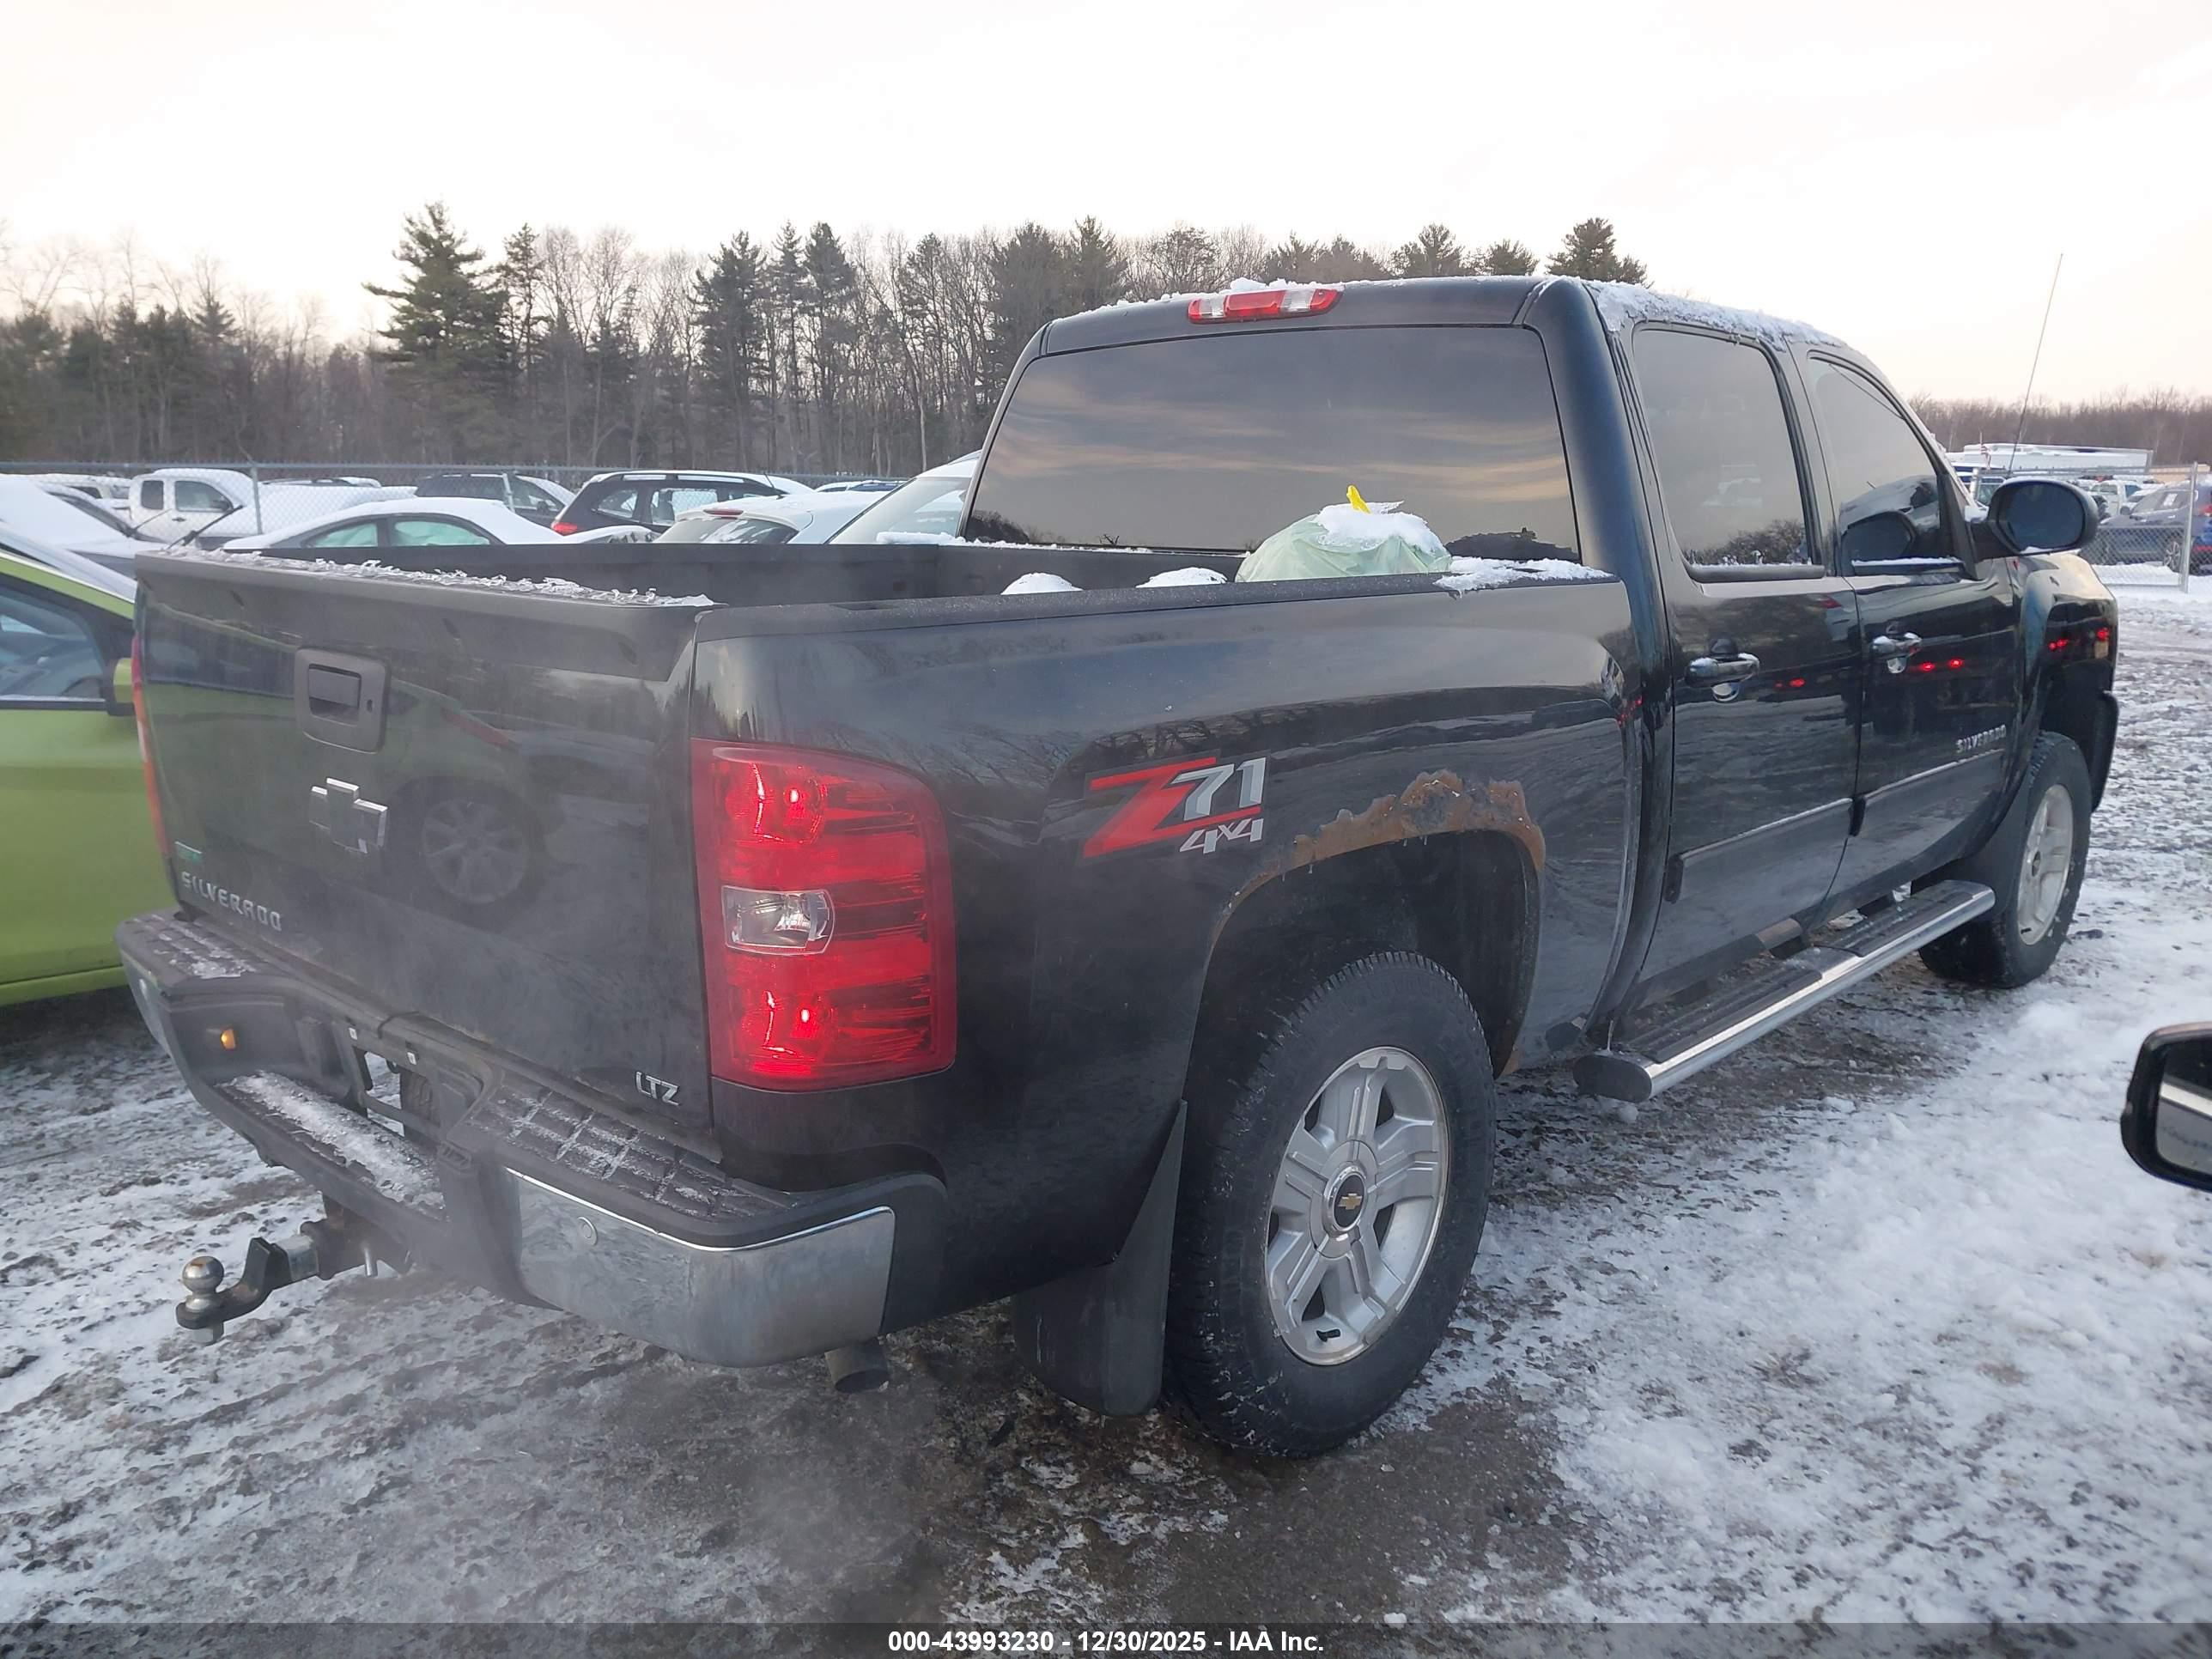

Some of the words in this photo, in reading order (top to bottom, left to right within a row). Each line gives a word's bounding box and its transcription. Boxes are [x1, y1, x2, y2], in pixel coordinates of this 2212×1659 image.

[1082, 756, 1267, 859] Z71
[181, 871, 283, 932] SILVERADO
[635, 1071, 679, 1106] LTZ
